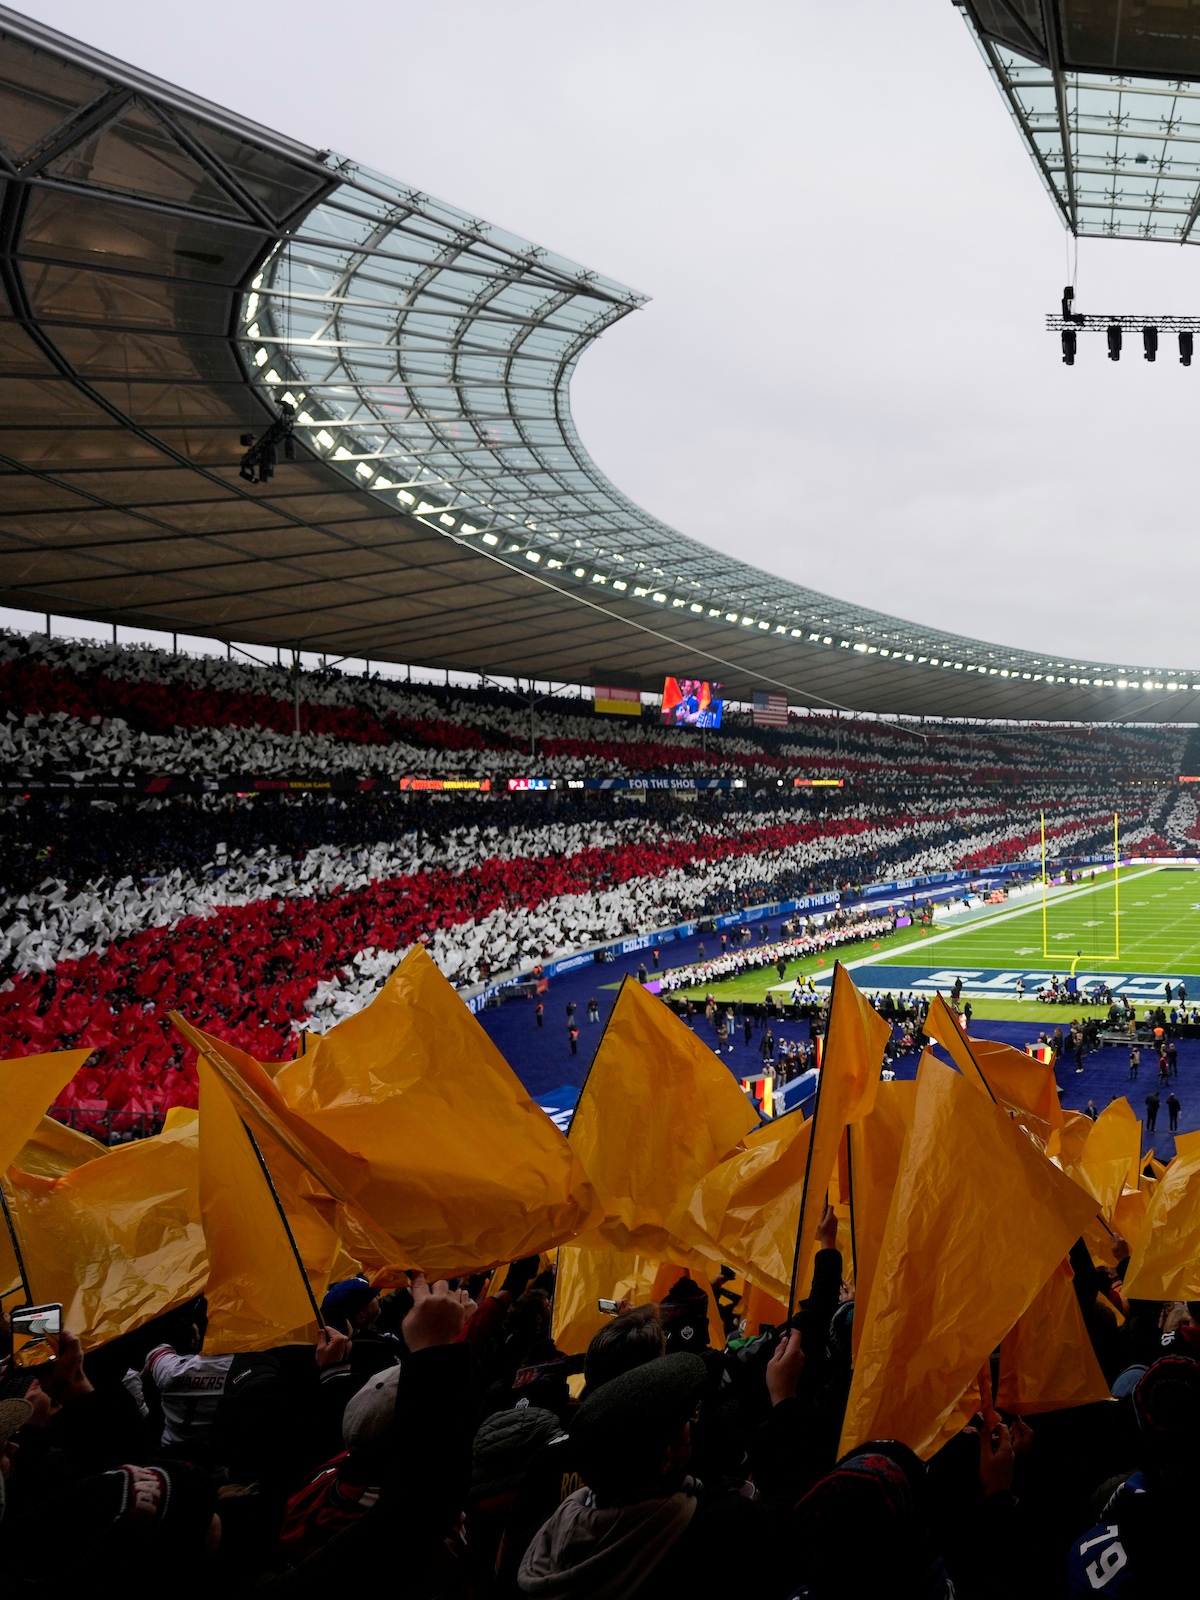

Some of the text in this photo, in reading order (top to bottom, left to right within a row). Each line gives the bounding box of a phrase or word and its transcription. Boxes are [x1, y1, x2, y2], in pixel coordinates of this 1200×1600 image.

[629, 779, 695, 789] FOR THE SHOE
[795, 899, 809, 909] FOR
[811, 896, 825, 907] THE
[622, 935, 649, 953] COLTS
[1079, 1524, 1128, 1590] 19
